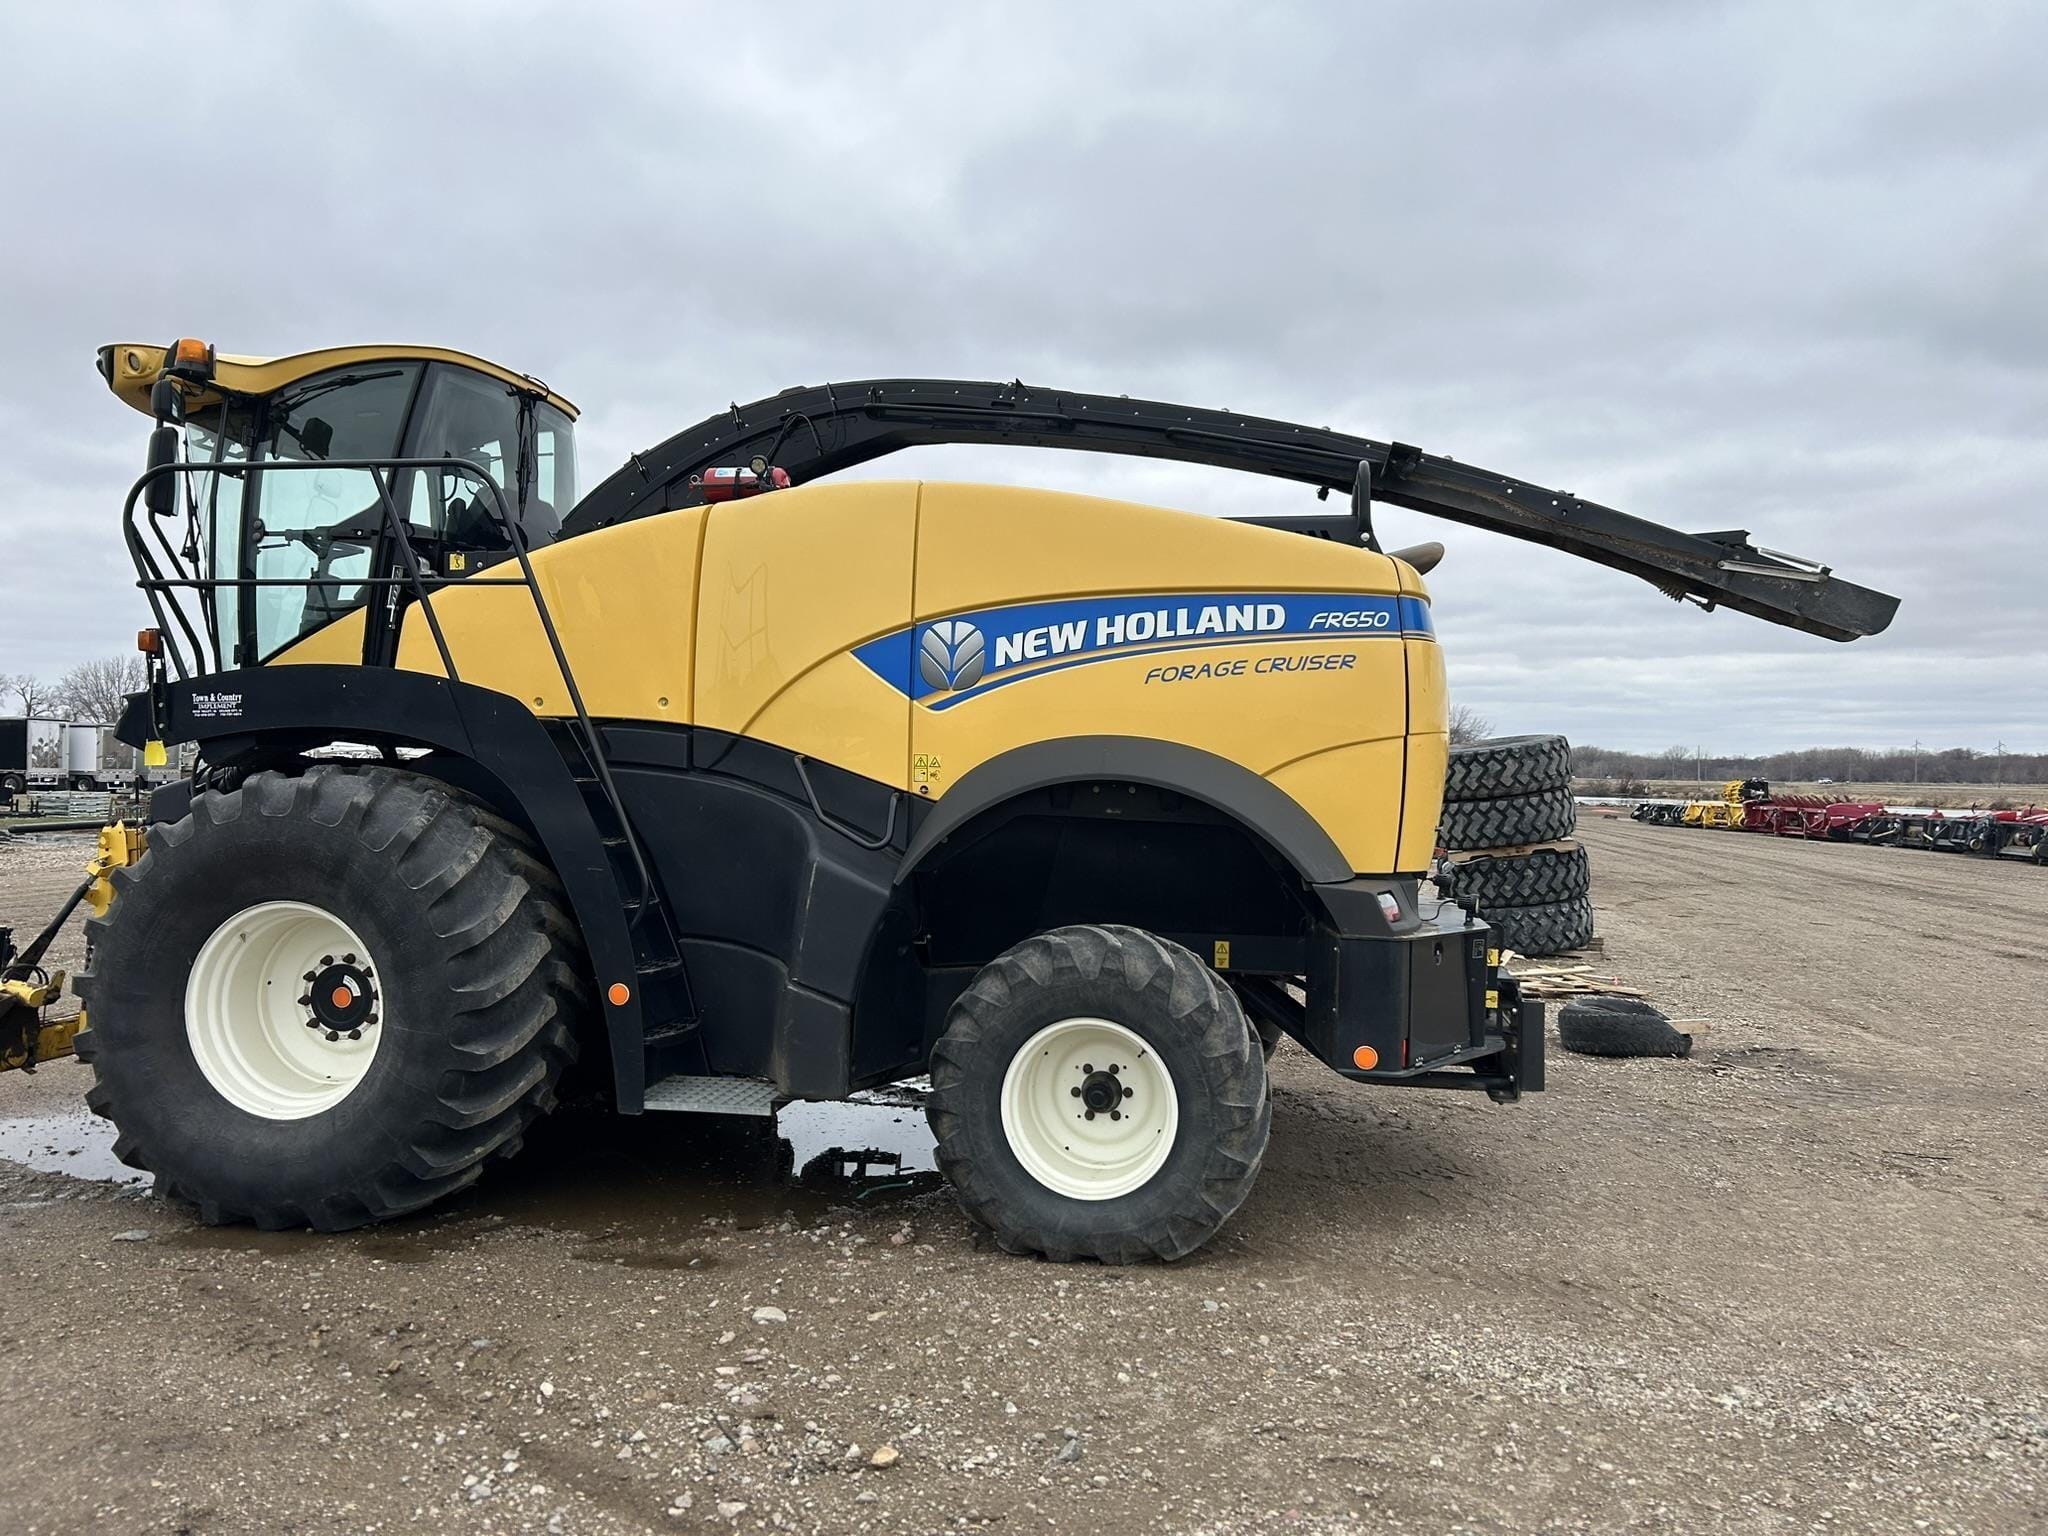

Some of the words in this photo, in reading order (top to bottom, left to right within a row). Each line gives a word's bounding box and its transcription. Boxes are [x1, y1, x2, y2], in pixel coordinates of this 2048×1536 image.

[1308, 611, 1390, 630] FR650
[994, 620, 1089, 667] NEW
[1096, 603, 1287, 647] HOLLAND
[1144, 659, 1249, 685] FORAGE
[1254, 653, 1358, 675] CRUISER
[191, 693, 209, 702] Town
[210, 692, 216, 702] &
[217, 692, 243, 704] Country
